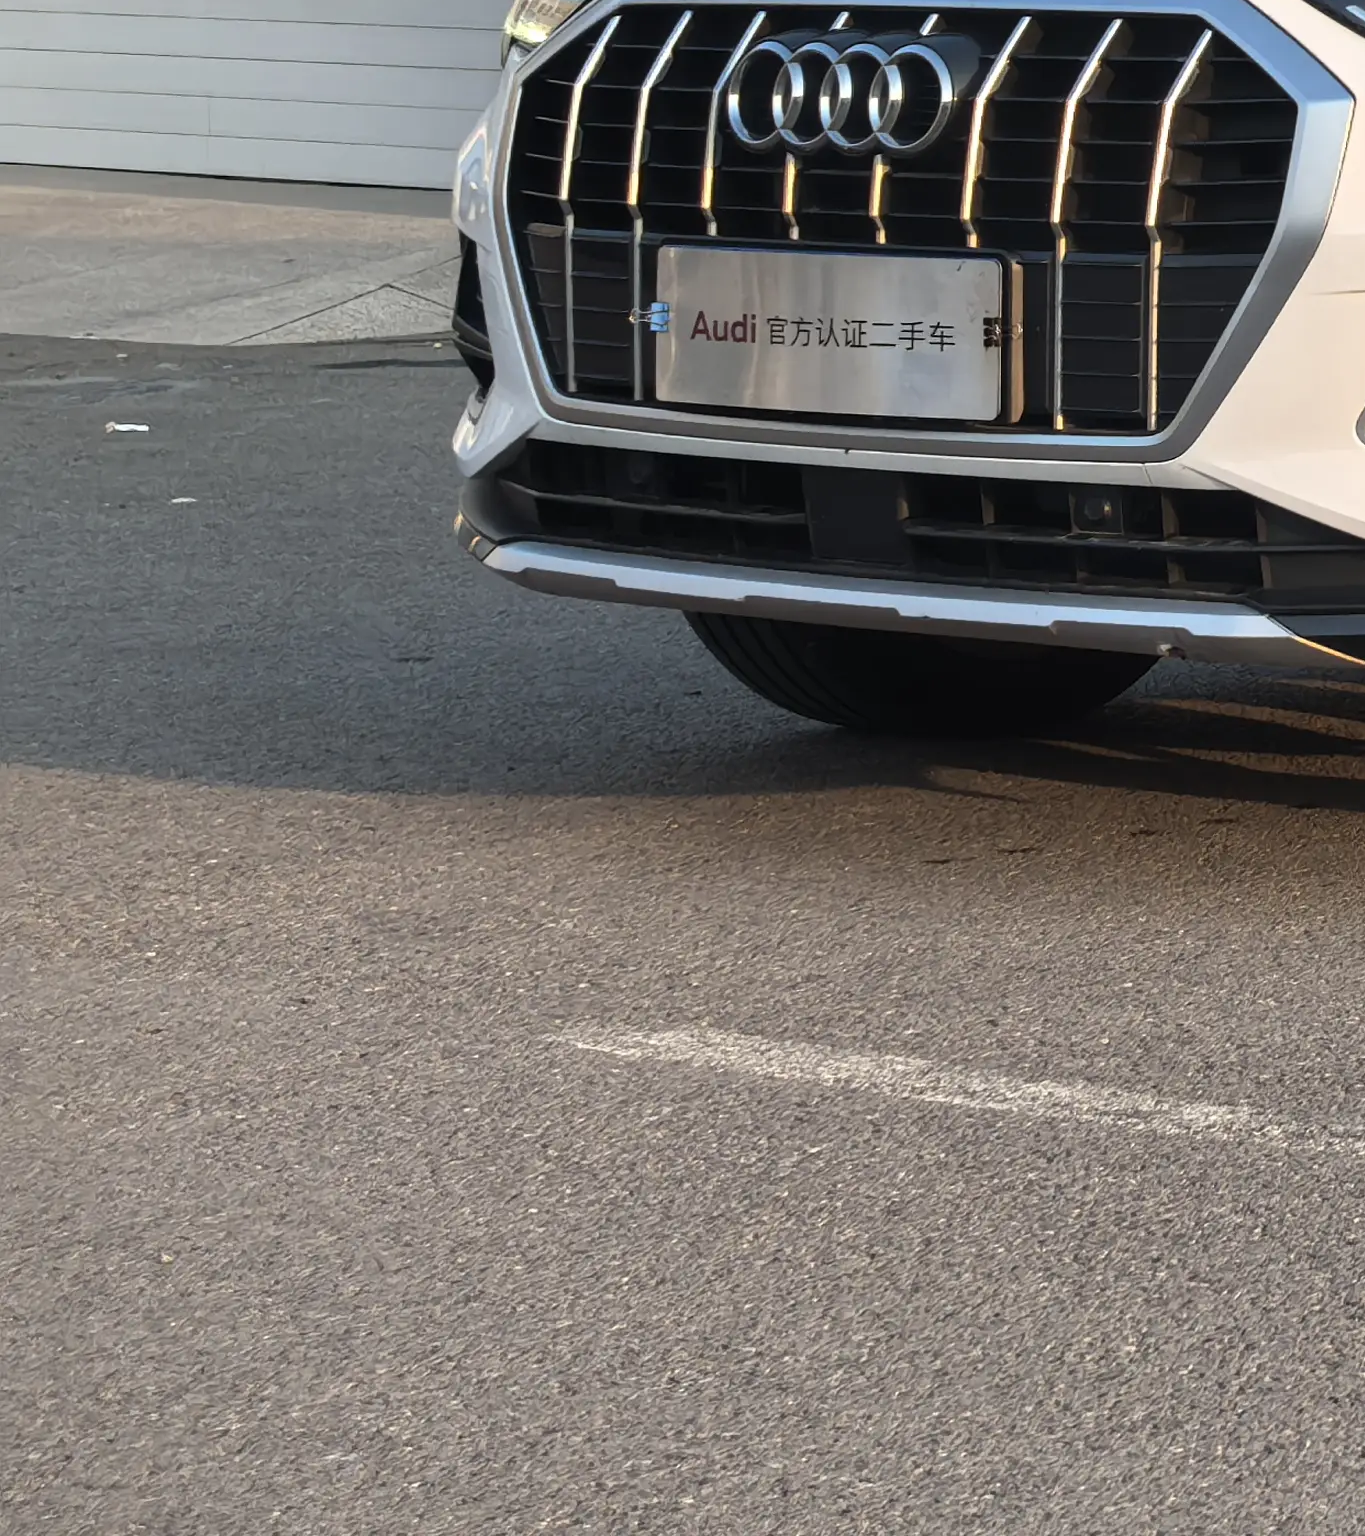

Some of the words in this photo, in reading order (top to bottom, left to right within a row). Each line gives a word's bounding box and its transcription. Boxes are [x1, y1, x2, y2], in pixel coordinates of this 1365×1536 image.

[690, 310, 757, 344] Audi
[766, 315, 956, 352] 官方认证二手车
